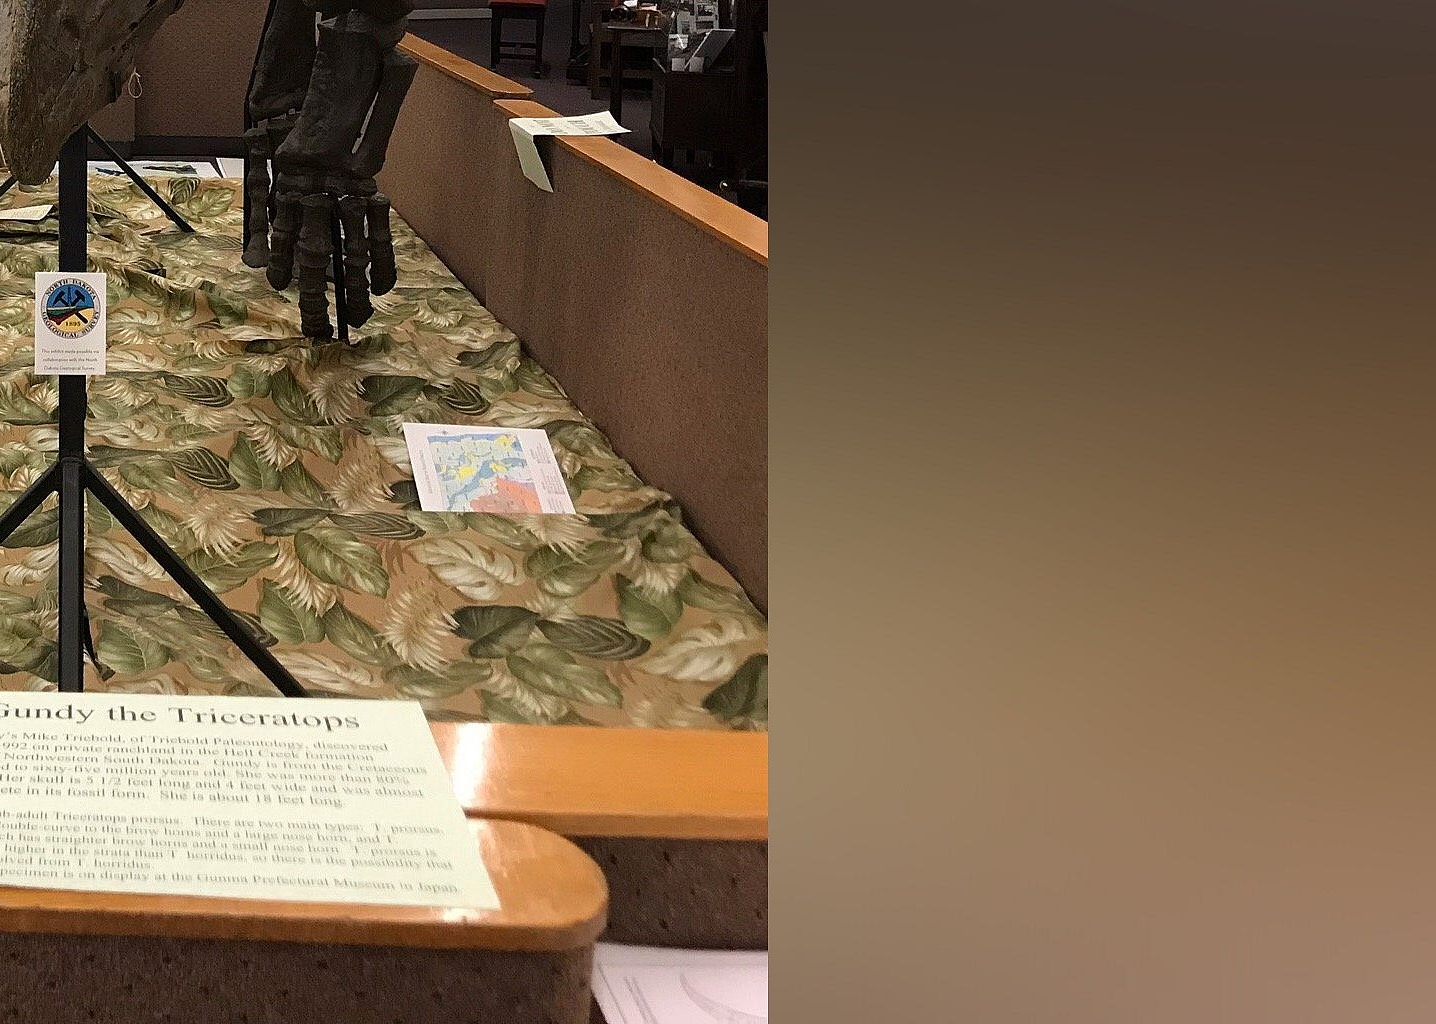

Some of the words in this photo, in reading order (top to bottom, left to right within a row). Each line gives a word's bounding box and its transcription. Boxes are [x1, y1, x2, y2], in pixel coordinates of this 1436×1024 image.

[46, 279, 70, 295] NORTH
[72, 279, 97, 300] DAKOTA
[42, 311, 78, 338] GEOLOGICAL
[82, 311, 100, 334] SURVEY
[108, 706, 157, 722] the
[168, 707, 360, 731] Triceratops
